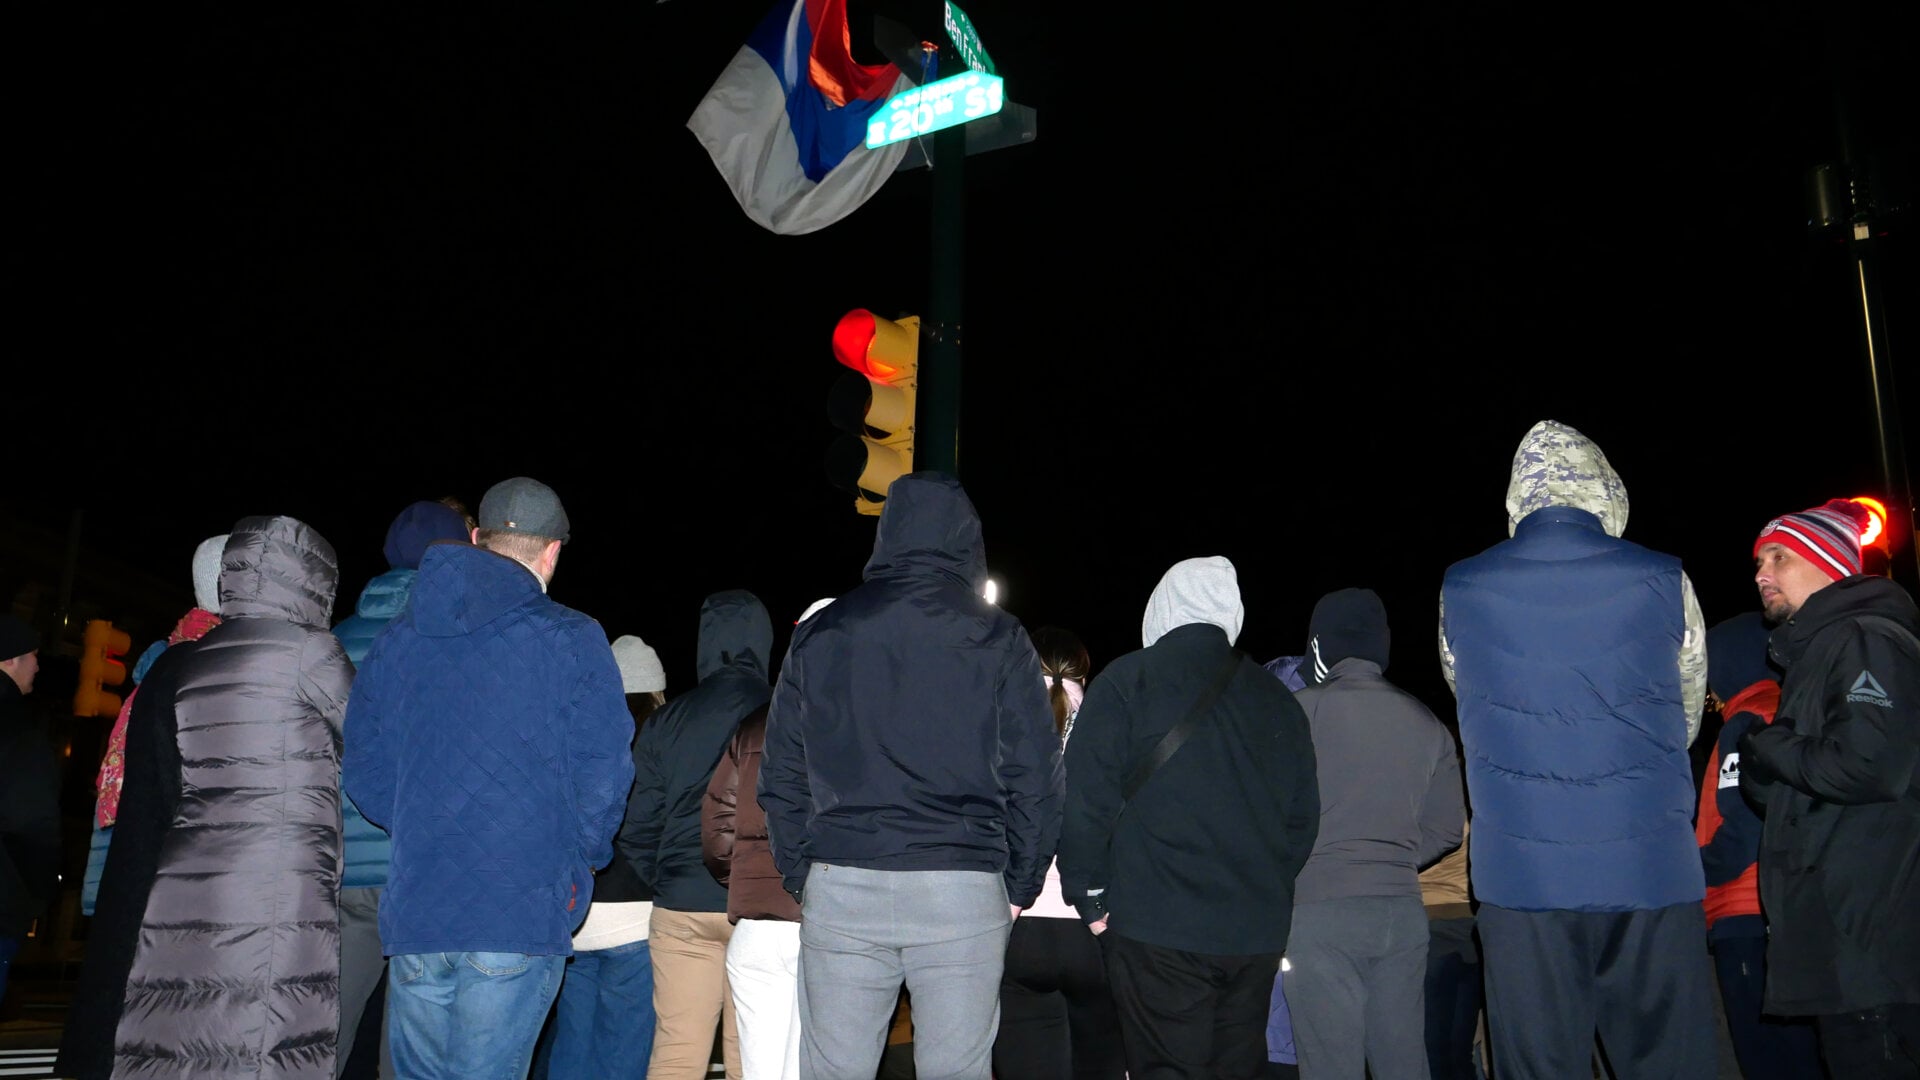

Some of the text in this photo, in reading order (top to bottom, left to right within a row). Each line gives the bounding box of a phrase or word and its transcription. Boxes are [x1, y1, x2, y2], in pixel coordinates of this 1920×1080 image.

[944, 1, 962, 51] Ben
[964, 79, 1003, 118] St
[1846, 694, 1894, 709] Reebok
